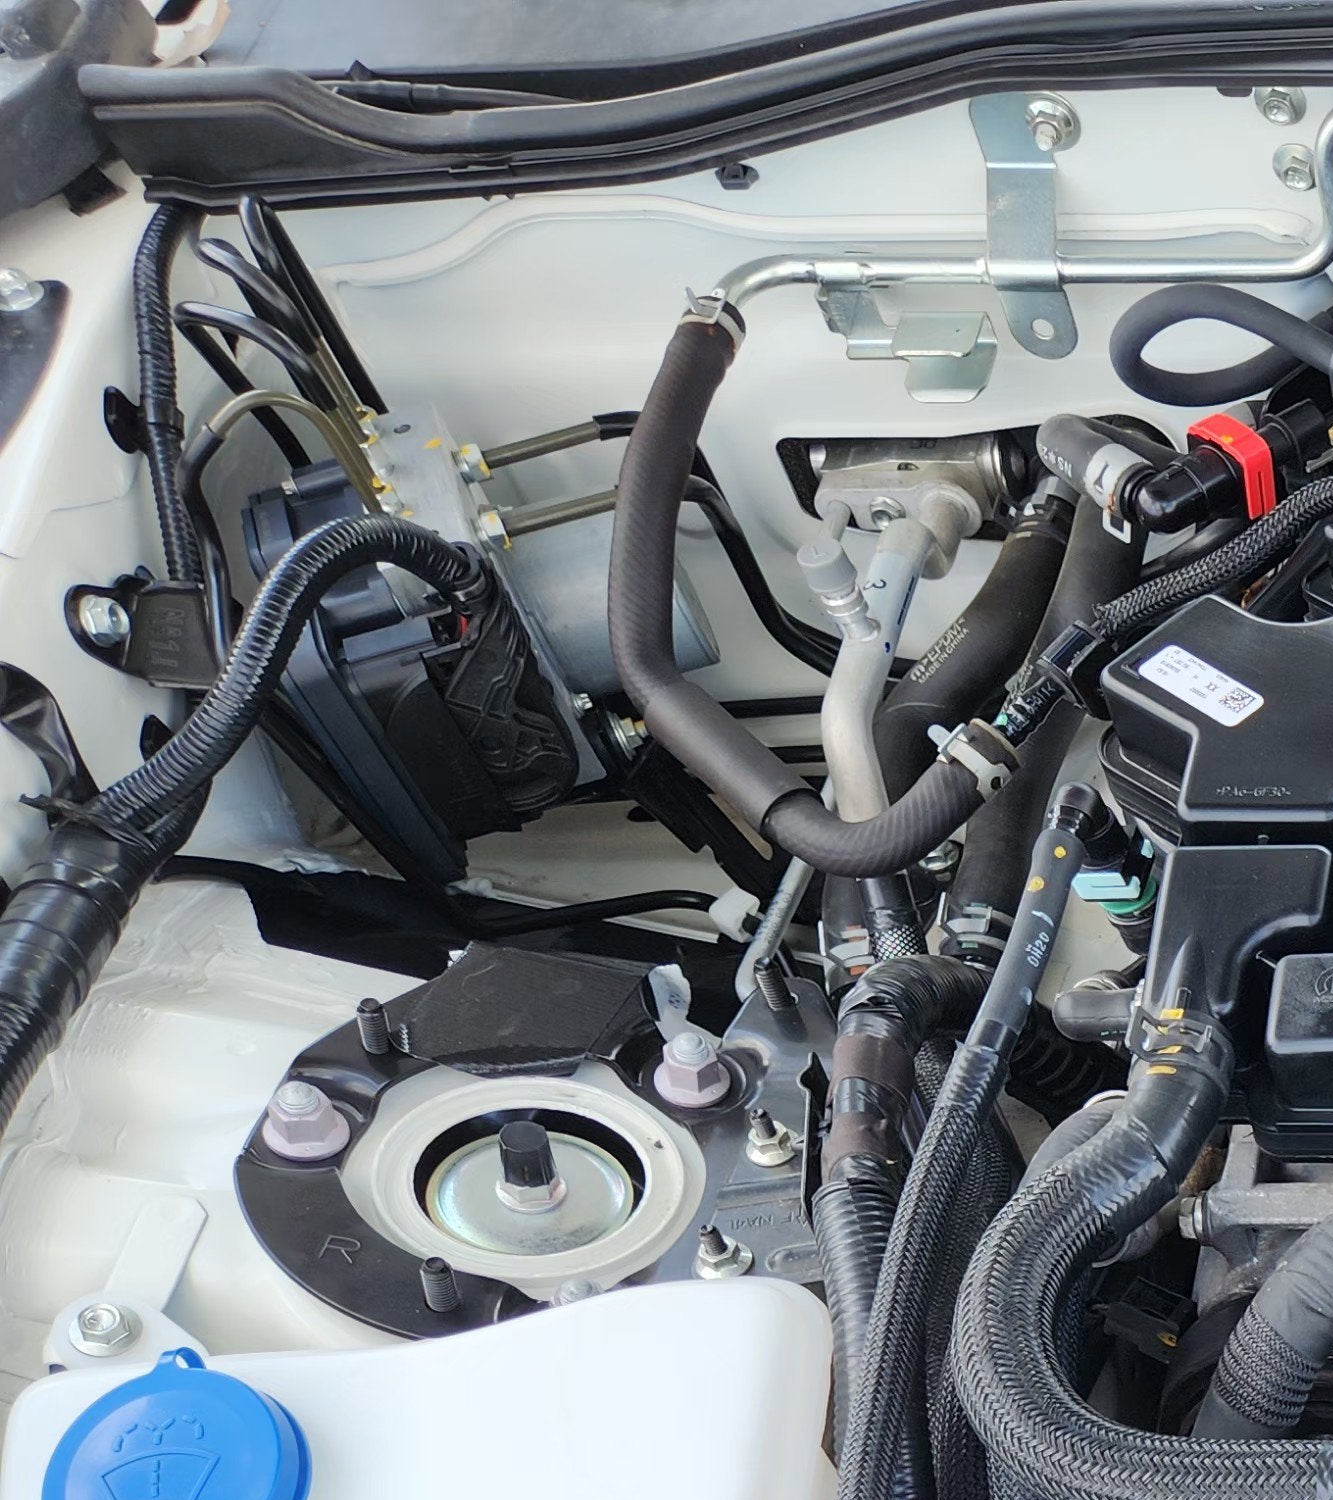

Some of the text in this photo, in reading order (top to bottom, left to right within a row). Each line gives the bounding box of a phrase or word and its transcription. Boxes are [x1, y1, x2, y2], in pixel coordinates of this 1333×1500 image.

[918, 660, 942, 685] MADE
[946, 628, 969, 654] CHINA
[318, 1234, 361, 1264] R
